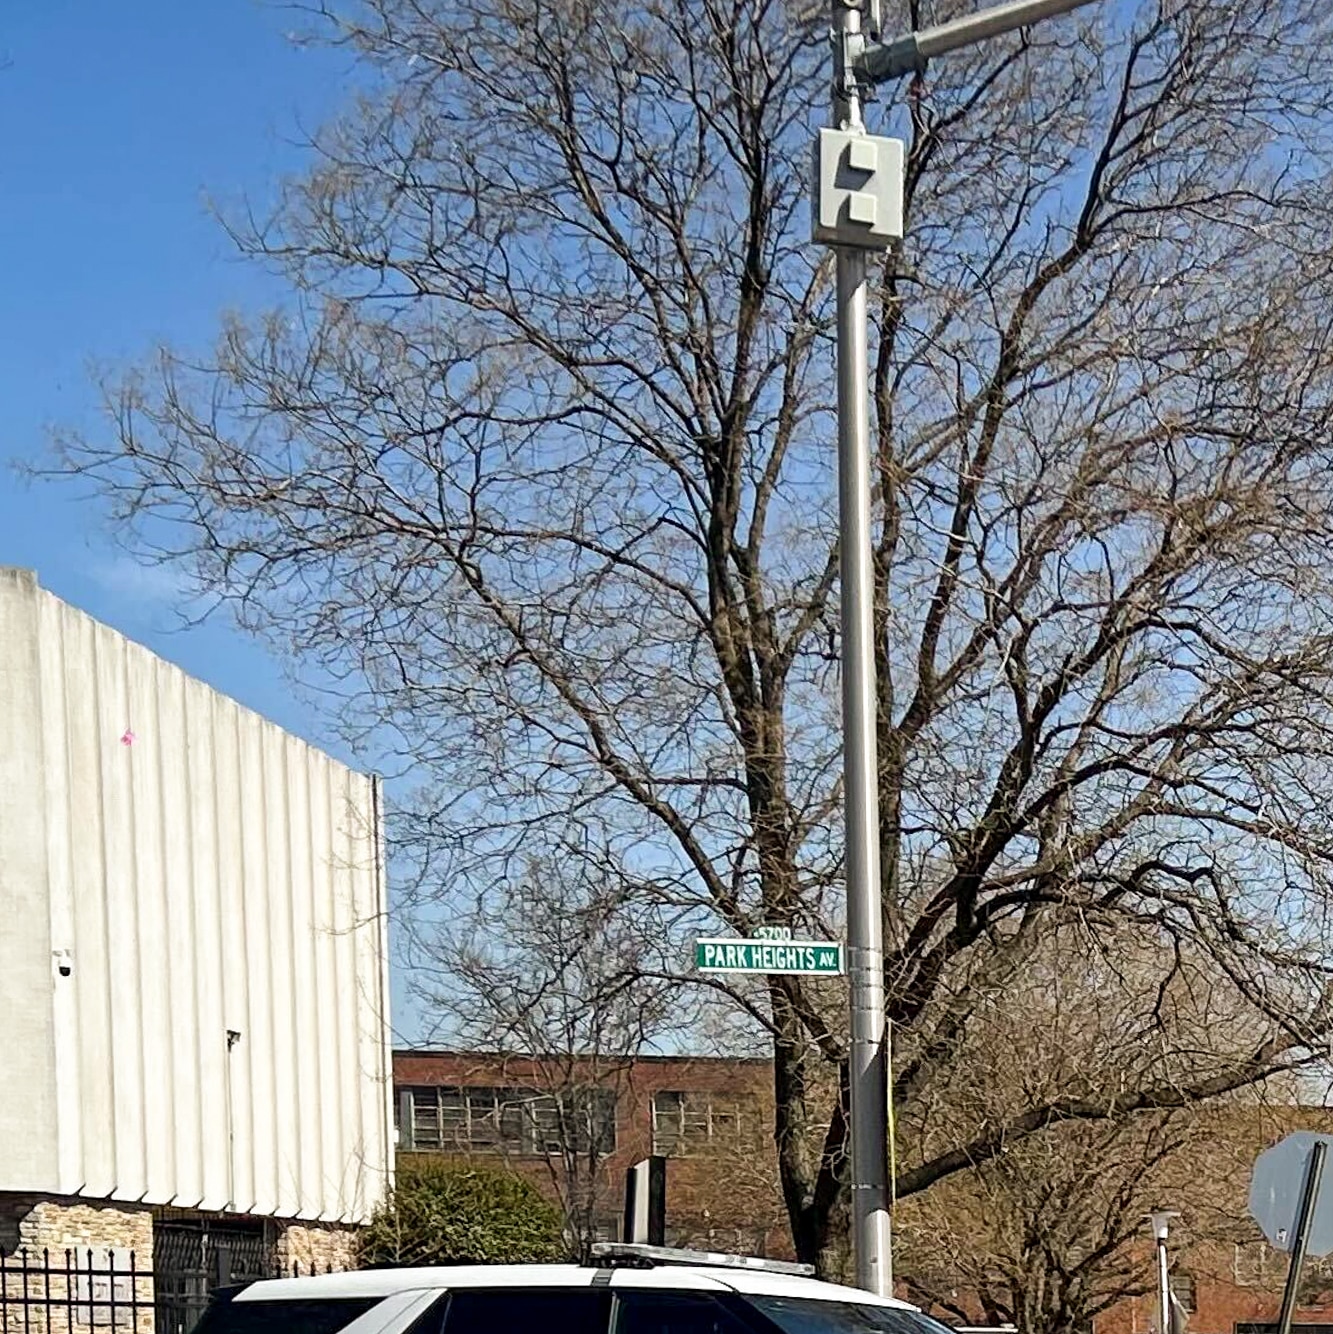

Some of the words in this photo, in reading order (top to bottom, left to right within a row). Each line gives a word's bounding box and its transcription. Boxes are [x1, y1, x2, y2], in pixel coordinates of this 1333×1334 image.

[758, 927, 791, 940] 5700
[705, 945, 747, 967] PARK
[752, 946, 816, 969] HEIGHTS
